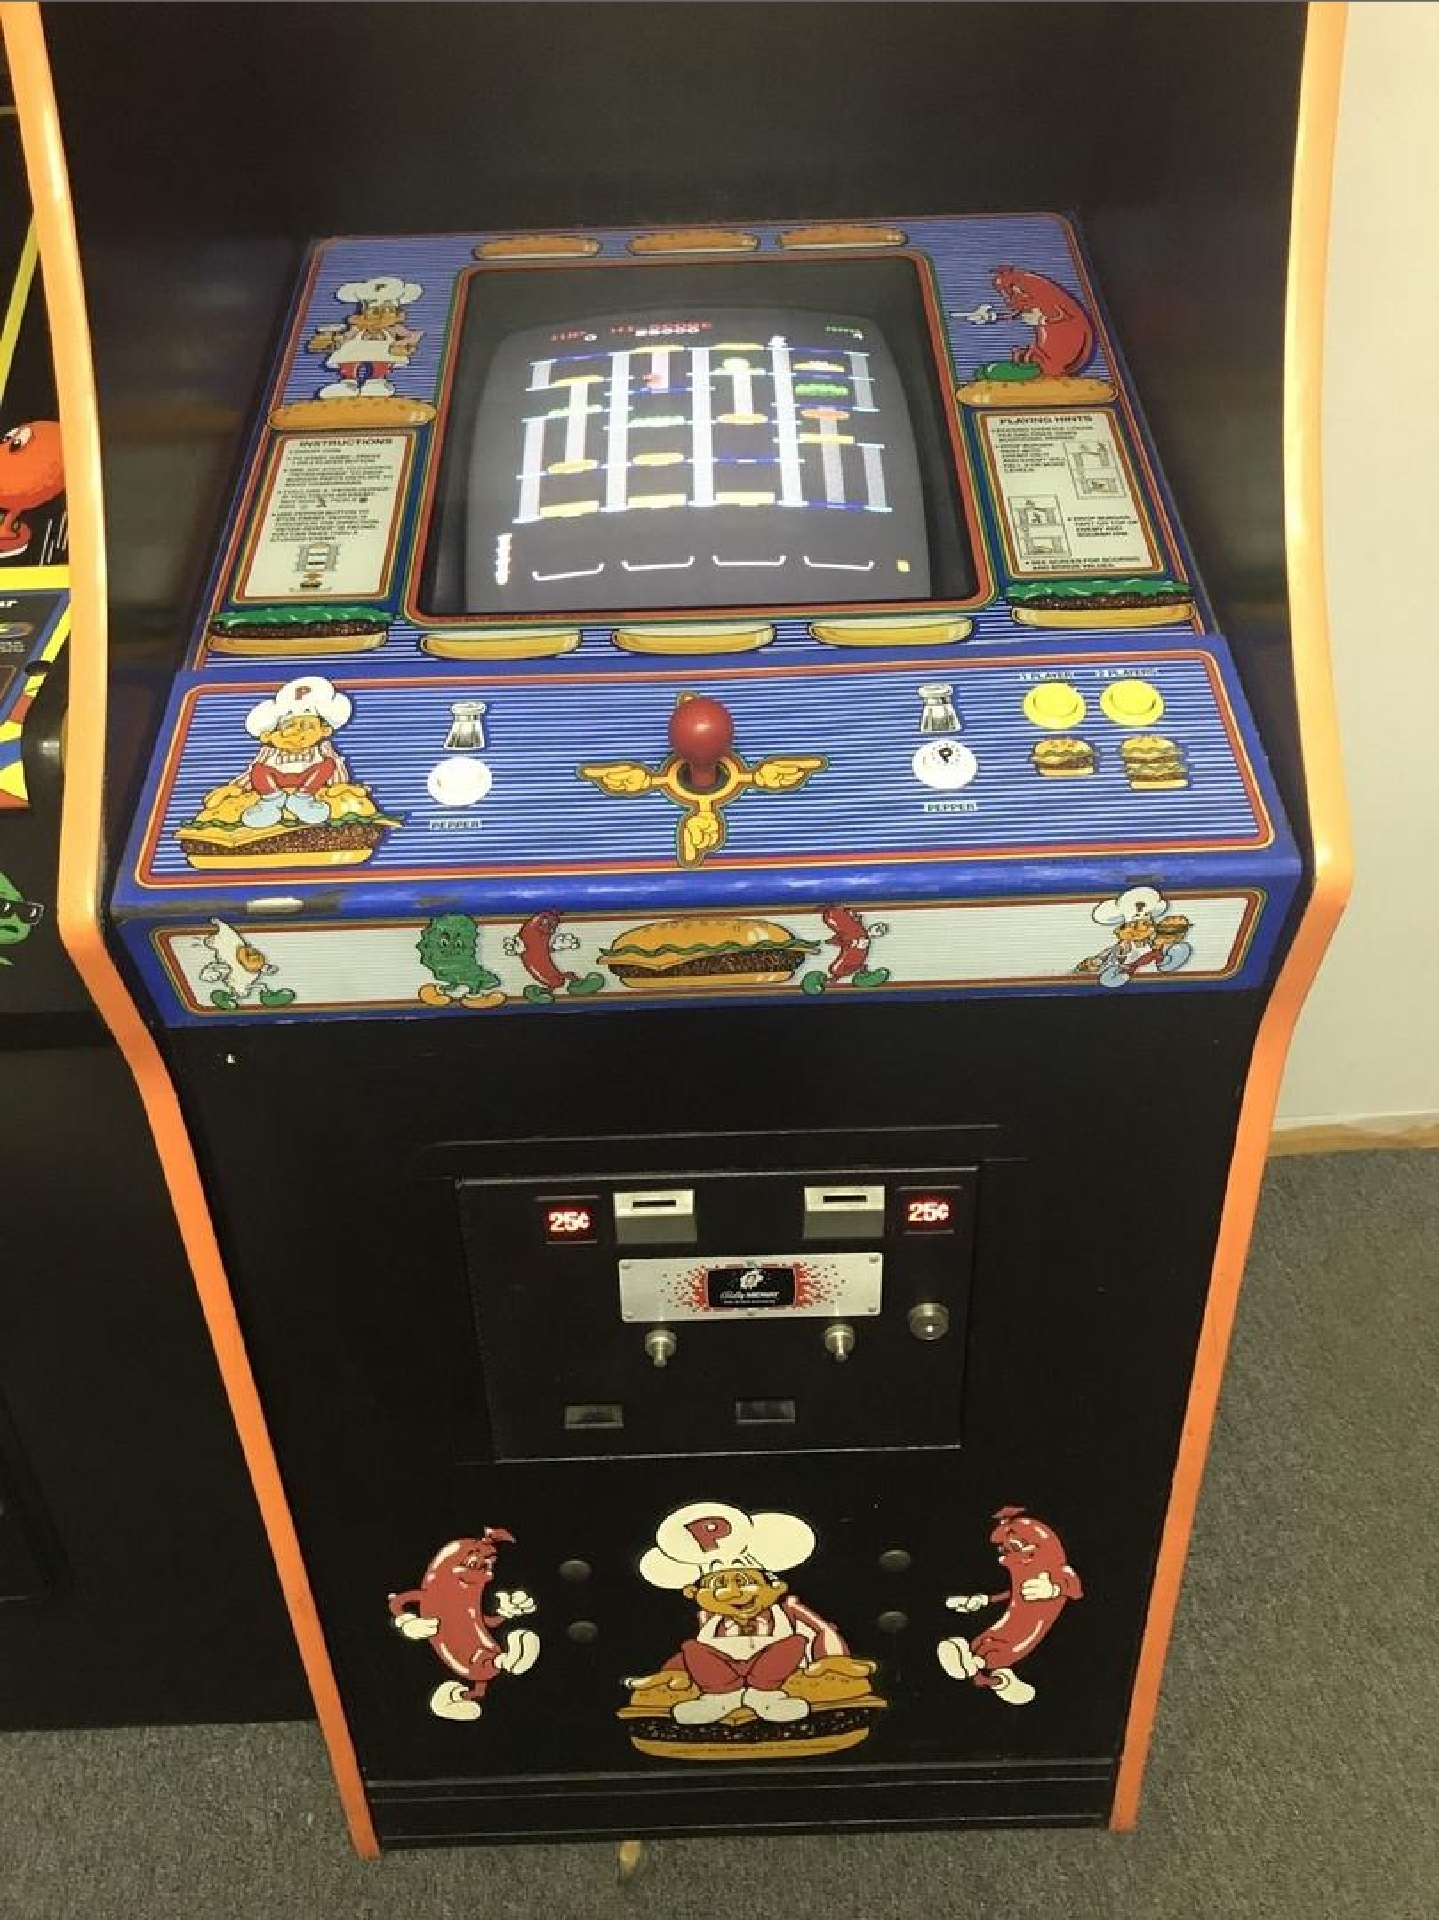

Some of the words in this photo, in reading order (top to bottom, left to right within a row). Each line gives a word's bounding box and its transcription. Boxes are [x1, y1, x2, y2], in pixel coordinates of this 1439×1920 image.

[1000, 417, 1052, 425] PLAYING
[1055, 415, 1093, 423] HINTS
[299, 438, 393, 447] INSTRUCTIONS
[927, 803, 976, 812] PEPPER
[431, 820, 479, 829] PEPPER
[908, 1202, 949, 1221] 25¢
[548, 1212, 590, 1231] 25¢
[683, 1515, 733, 1554] P
